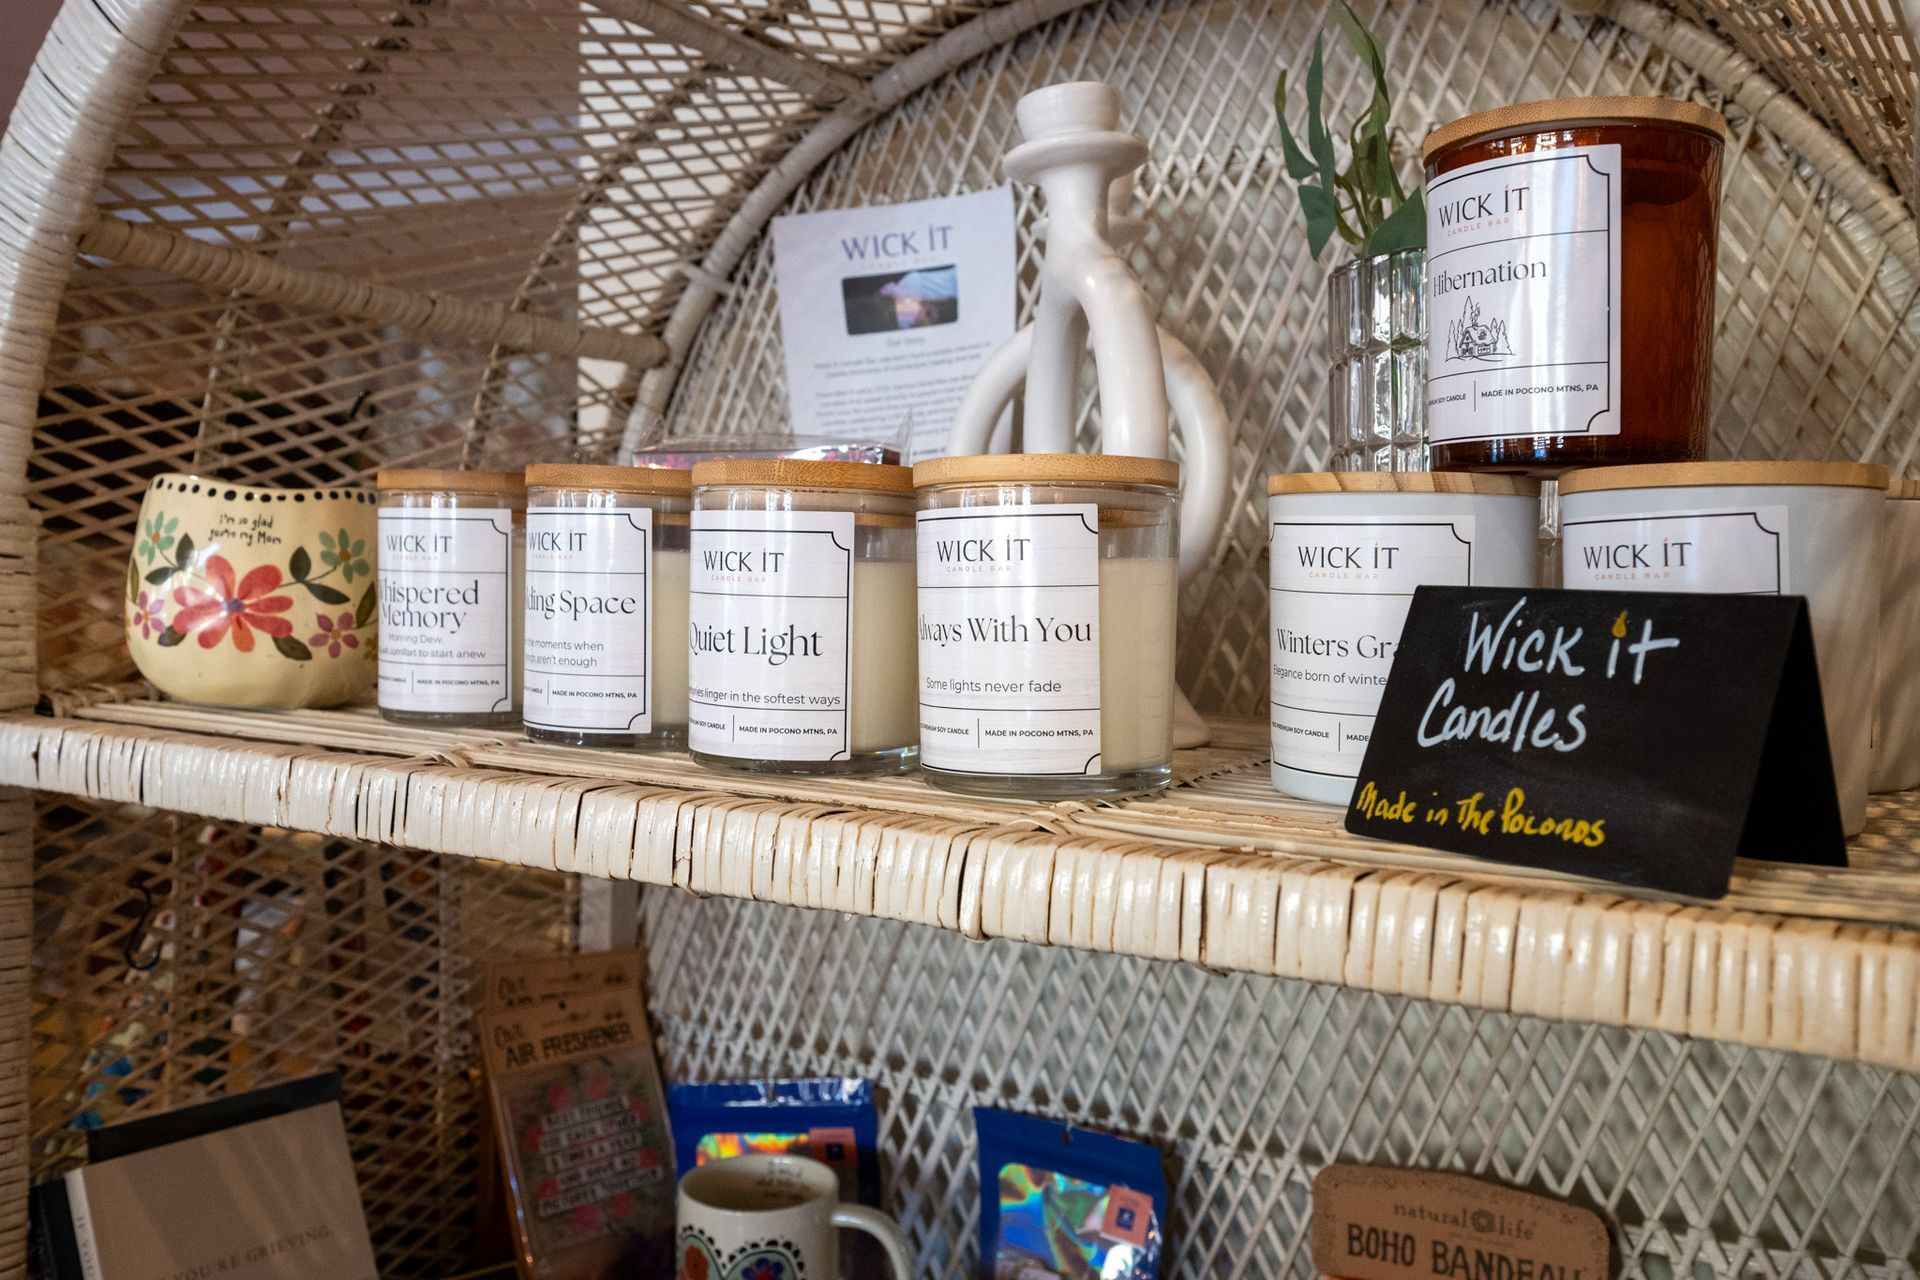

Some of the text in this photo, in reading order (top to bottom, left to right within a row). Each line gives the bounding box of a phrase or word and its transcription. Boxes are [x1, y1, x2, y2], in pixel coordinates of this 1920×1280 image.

[1438, 193, 1493, 229] WICK
[1447, 217, 1511, 237] CANDLE BAR
[841, 230, 919, 261] WICK
[1433, 260, 1547, 297] Hibernation
[1481, 384, 1599, 398] MADE IN POCONO MTNS, PA
[251, 512, 274, 531] glad
[240, 531, 253, 547] my
[257, 530, 282, 545] Mom
[386, 535, 426, 553] WICK
[528, 531, 562, 551] WICK
[703, 550, 753, 572] WICK
[936, 539, 995, 563] WICK
[1297, 546, 1363, 569] WICK
[1583, 543, 1651, 570] WICK
[946, 564, 1012, 573] CANDLE BAR
[1309, 571, 1379, 580] CANDLE BAR
[1594, 570, 1671, 581] CANDLE BAR
[380, 576, 479, 612] hispered
[559, 589, 636, 621] Space
[382, 603, 467, 634] Memory
[967, 614, 1029, 643] With
[1035, 616, 1092, 643] You
[535, 639, 572, 651] moments
[574, 641, 604, 652] when
[689, 621, 824, 666] Quiet Light
[1276, 628, 1349, 658] Winters
[418, 649, 428, 657] to
[430, 650, 453, 658] start
[456, 651, 486, 659] anew
[558, 657, 598, 669] enough
[1273, 664, 1388, 686] Elegance born of winte
[926, 677, 1062, 694] Some lights never fade
[705, 687, 728, 702] linger
[729, 690, 740, 702] in
[742, 691, 761, 704] the
[763, 693, 806, 705] softest
[808, 696, 841, 707] ways
[1417, 677, 1587, 752] Candles
[707, 721, 726, 730] CANDLE
[739, 725, 758, 734] MADE
[759, 726, 768, 734] IN
[769, 727, 802, 735] POCONO
[802, 728, 826, 736] MTNS,
[946, 727, 970, 735] CANDLE
[984, 729, 1094, 738] MADE IN POCONO MTNS, PA
[1293, 727, 1304, 735] SOY
[1304, 729, 1330, 739] CANDLE
[1346, 733, 1370, 742] MADE
[1356, 781, 1606, 847] Made in The Poconos
[505, 1041, 538, 1069] AIR
[541, 1021, 634, 1060] FRESHENER
[1393, 1202, 1468, 1228] natural
[1499, 1214, 1535, 1241] life
[1345, 1223, 1416, 1268] BOHO
